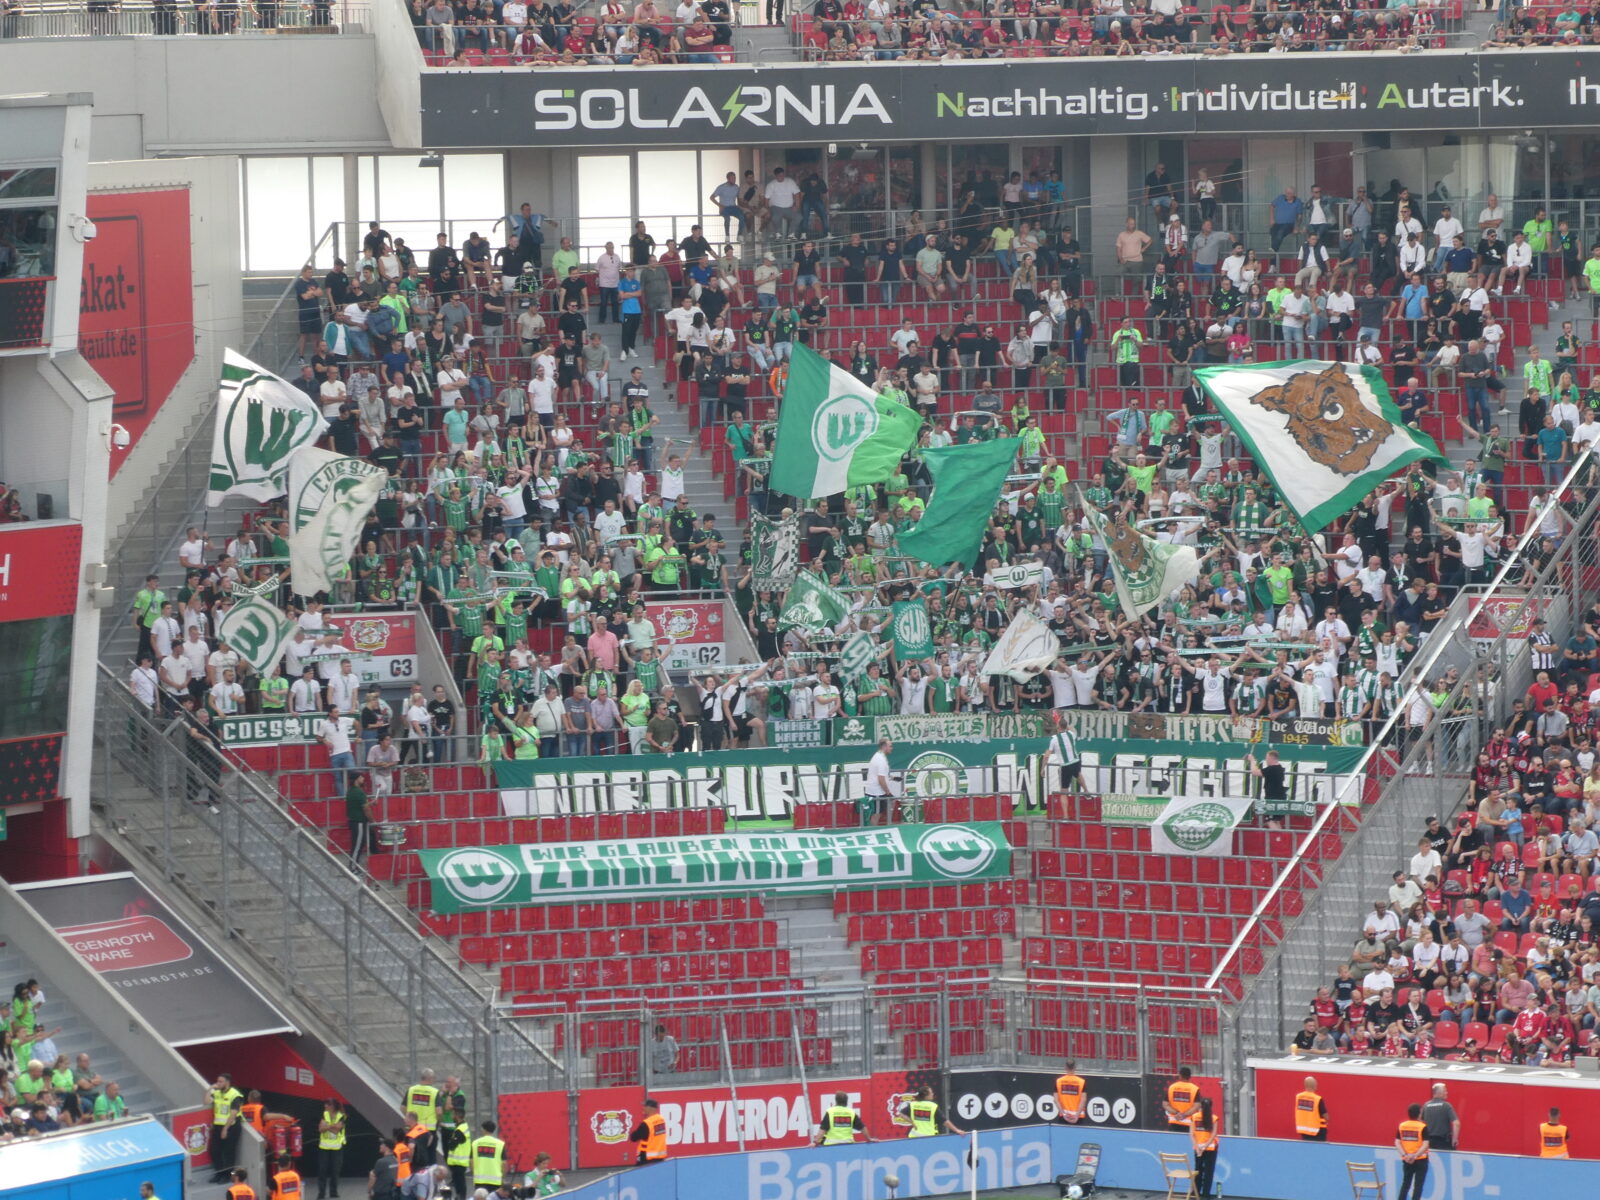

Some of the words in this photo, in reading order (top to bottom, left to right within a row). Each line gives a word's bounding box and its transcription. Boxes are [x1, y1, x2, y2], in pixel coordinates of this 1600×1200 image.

[535, 83, 893, 130] SOLARNIA
[936, 84, 1158, 121] Nachhaltig.
[1171, 82, 1367, 113] Individuell.
[1377, 77, 1524, 109] Autark.
[389, 658, 413, 677] G3
[698, 646, 721, 665] G2
[1282, 733, 1309, 745] 1945
[530, 846, 585, 861] WIR
[597, 838, 739, 857] GLAUBEN
[750, 837, 787, 850] AN
[800, 832, 893, 849] UNSER
[747, 1130, 1050, 1200] Barmenia
